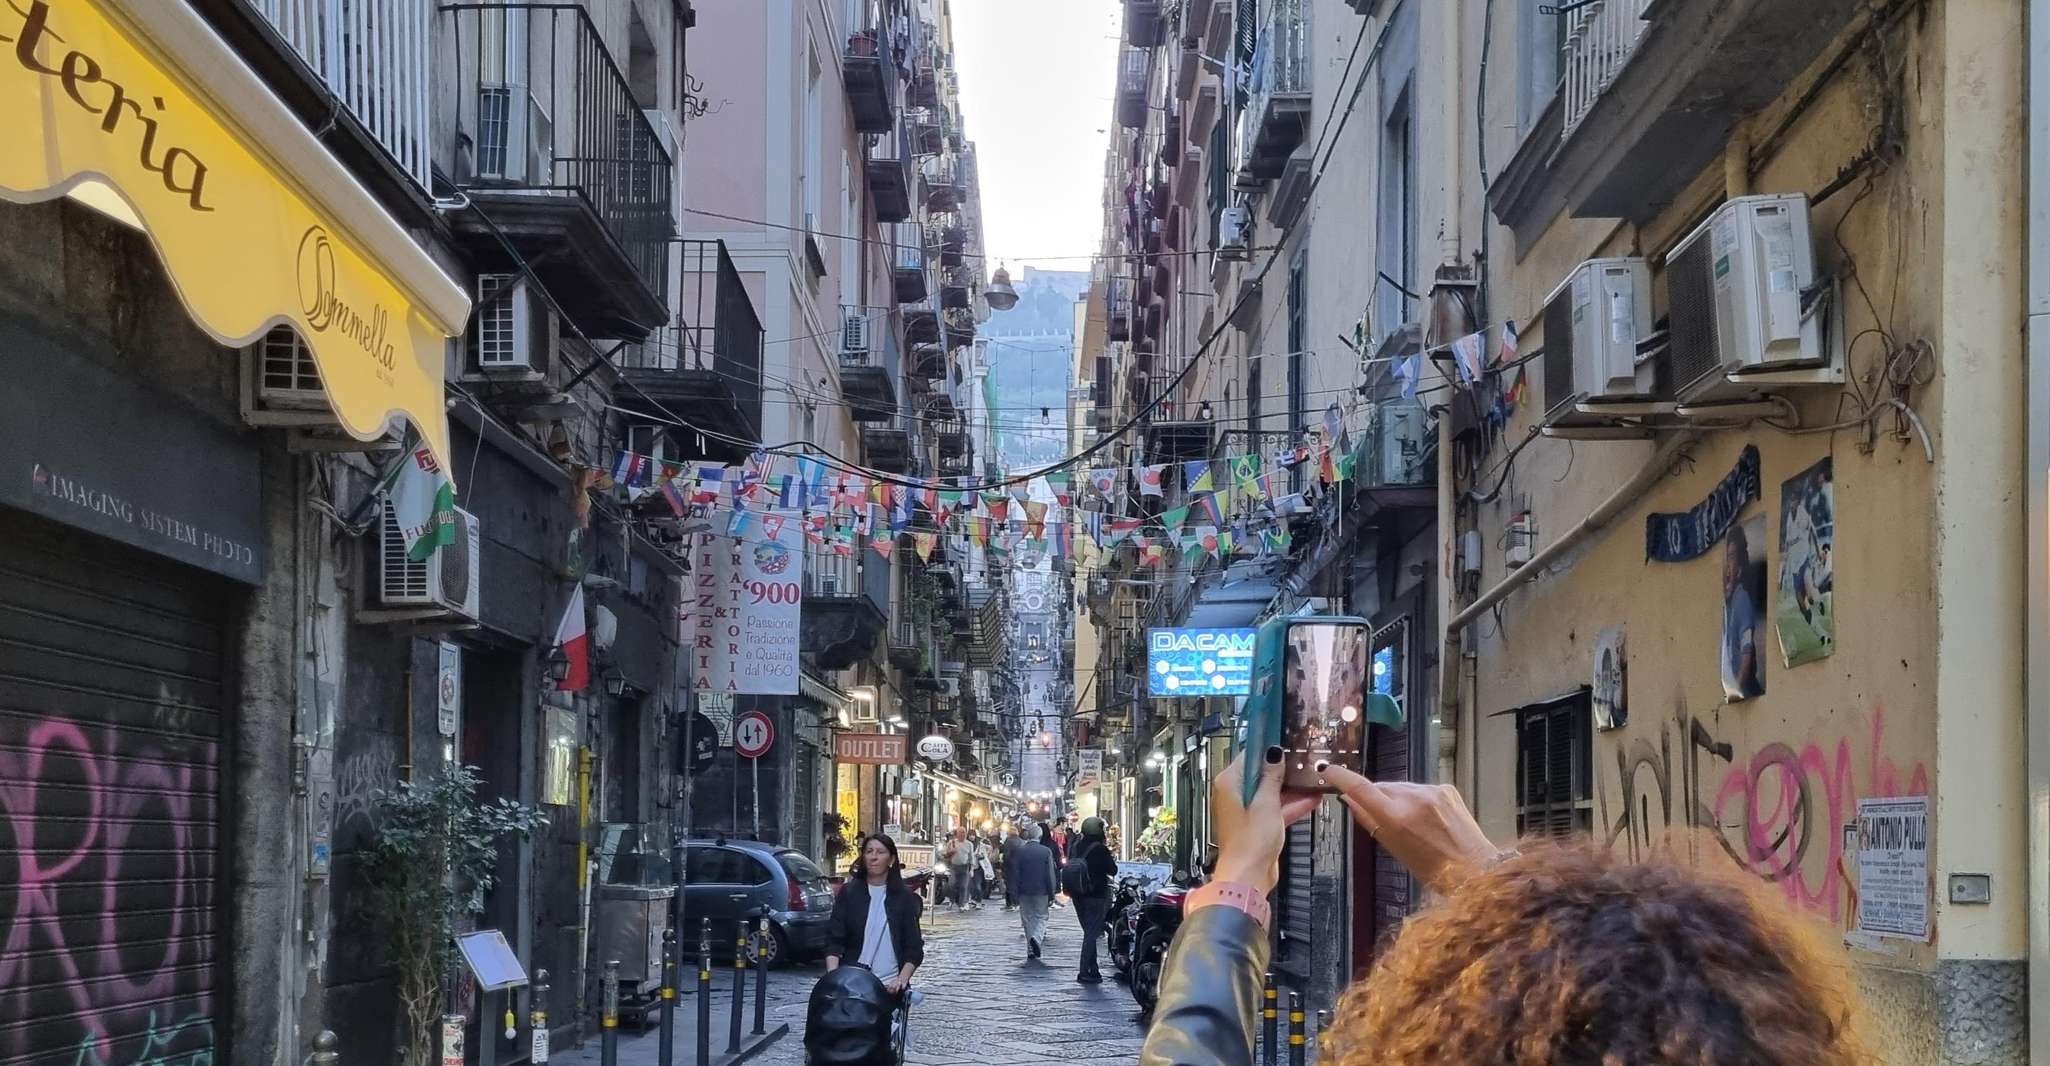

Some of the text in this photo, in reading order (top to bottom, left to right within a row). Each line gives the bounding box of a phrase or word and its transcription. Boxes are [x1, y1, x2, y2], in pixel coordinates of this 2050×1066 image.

[0, 0, 214, 212] teria
[297, 224, 395, 371] Sommella
[51, 474, 133, 524] IMAGING
[140, 508, 198, 546] SISTEM
[695, 532, 716, 690] PIZZERIA
[747, 615, 793, 629] Passione
[745, 631, 796, 645] Tradizione
[745, 663, 793, 677] dal 1960
[841, 740, 901, 759] OUTLET
[1871, 815, 1903, 850] ANTONIO
